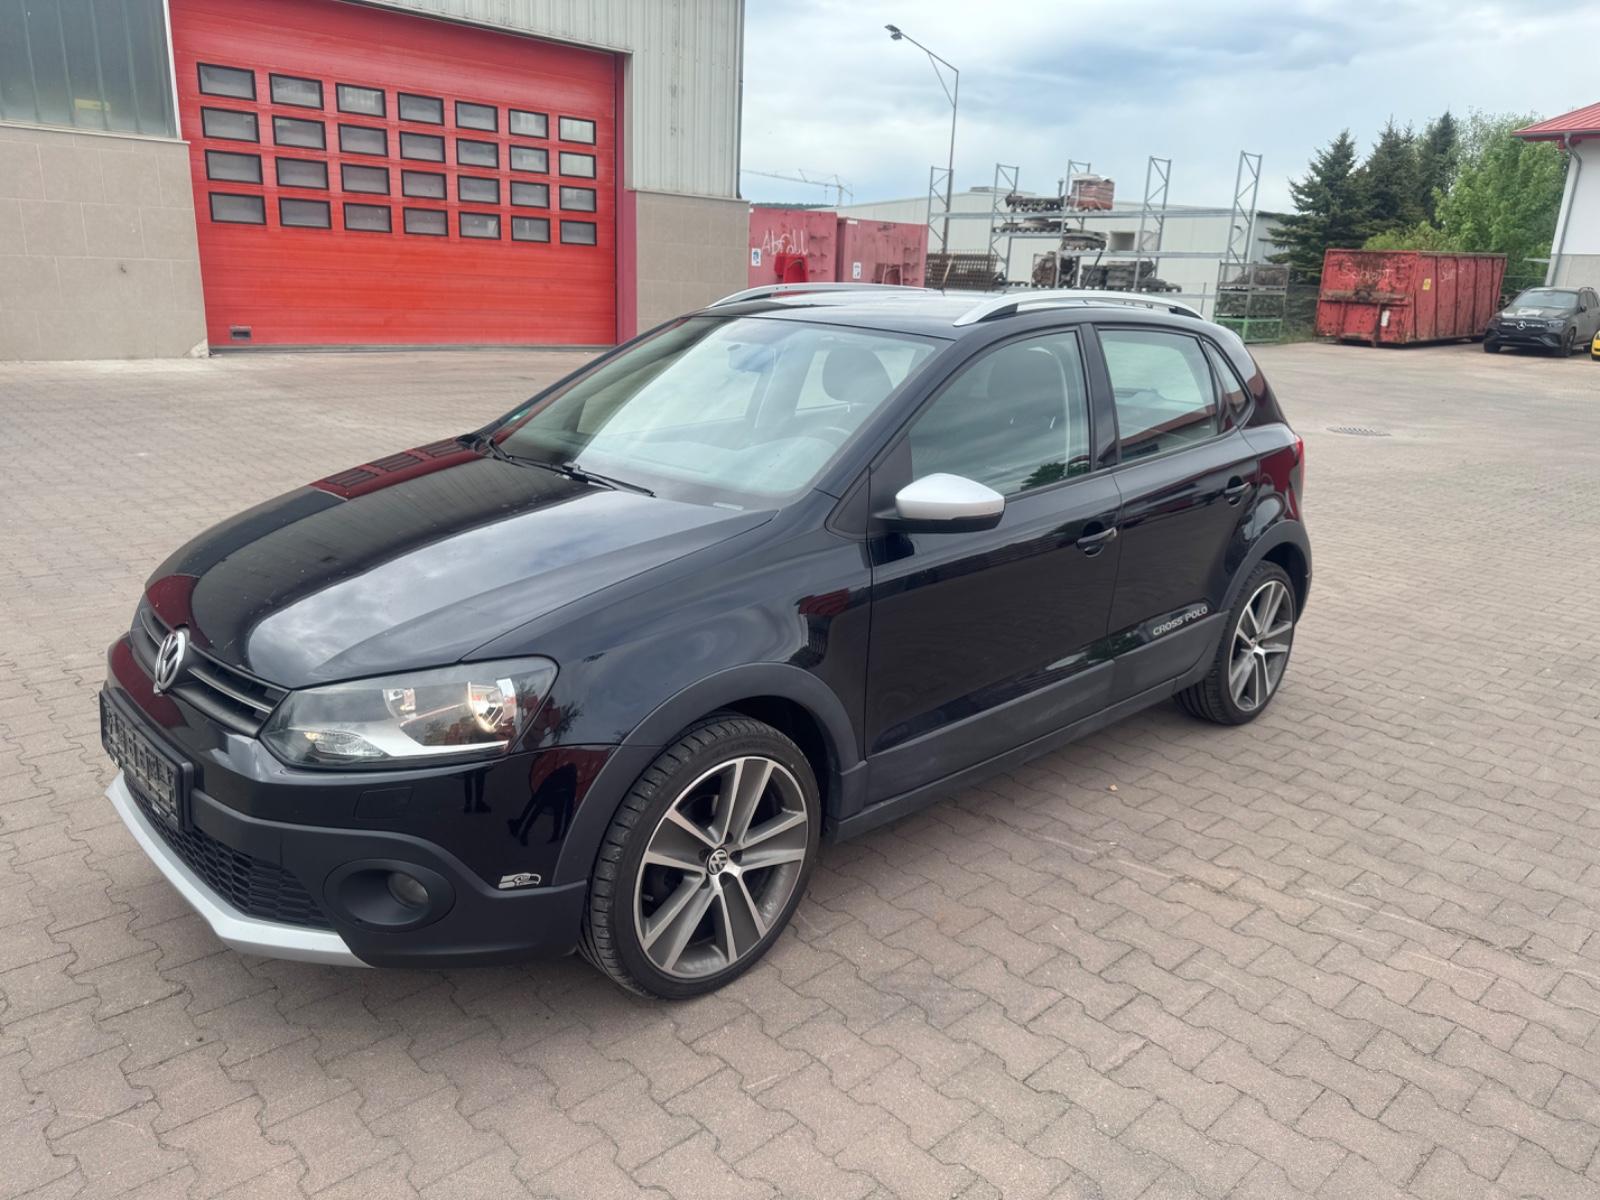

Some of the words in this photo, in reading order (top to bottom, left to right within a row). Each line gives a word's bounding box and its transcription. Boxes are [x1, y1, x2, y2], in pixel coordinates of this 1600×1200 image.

[762, 229, 808, 256] Abfall
[1153, 616, 1183, 635] CROSS
[1185, 606, 1208, 622] POLO
